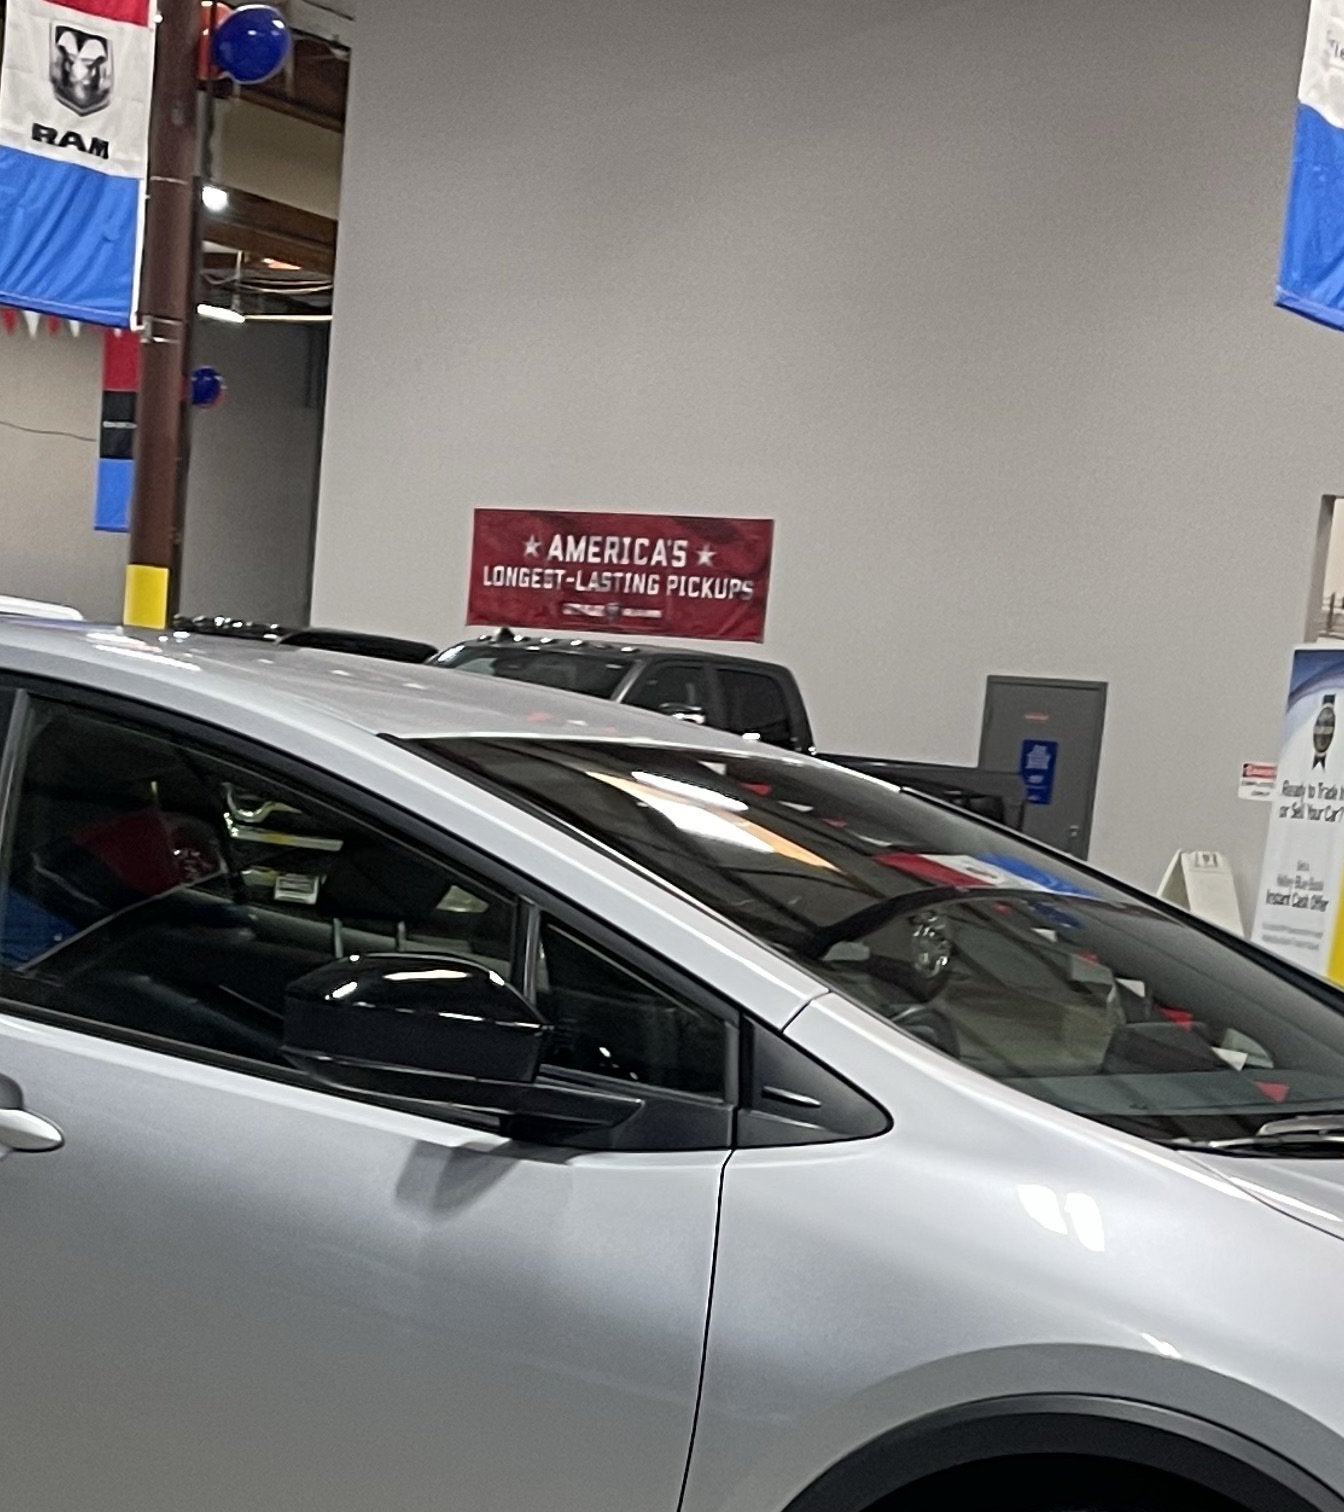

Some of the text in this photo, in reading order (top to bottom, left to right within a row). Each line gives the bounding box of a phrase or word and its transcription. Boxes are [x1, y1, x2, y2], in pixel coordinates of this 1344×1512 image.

[32, 122, 109, 160] RAM
[546, 534, 689, 568] AMERICA'S
[482, 565, 754, 601] LONGEST-LASTING PICKUPS
